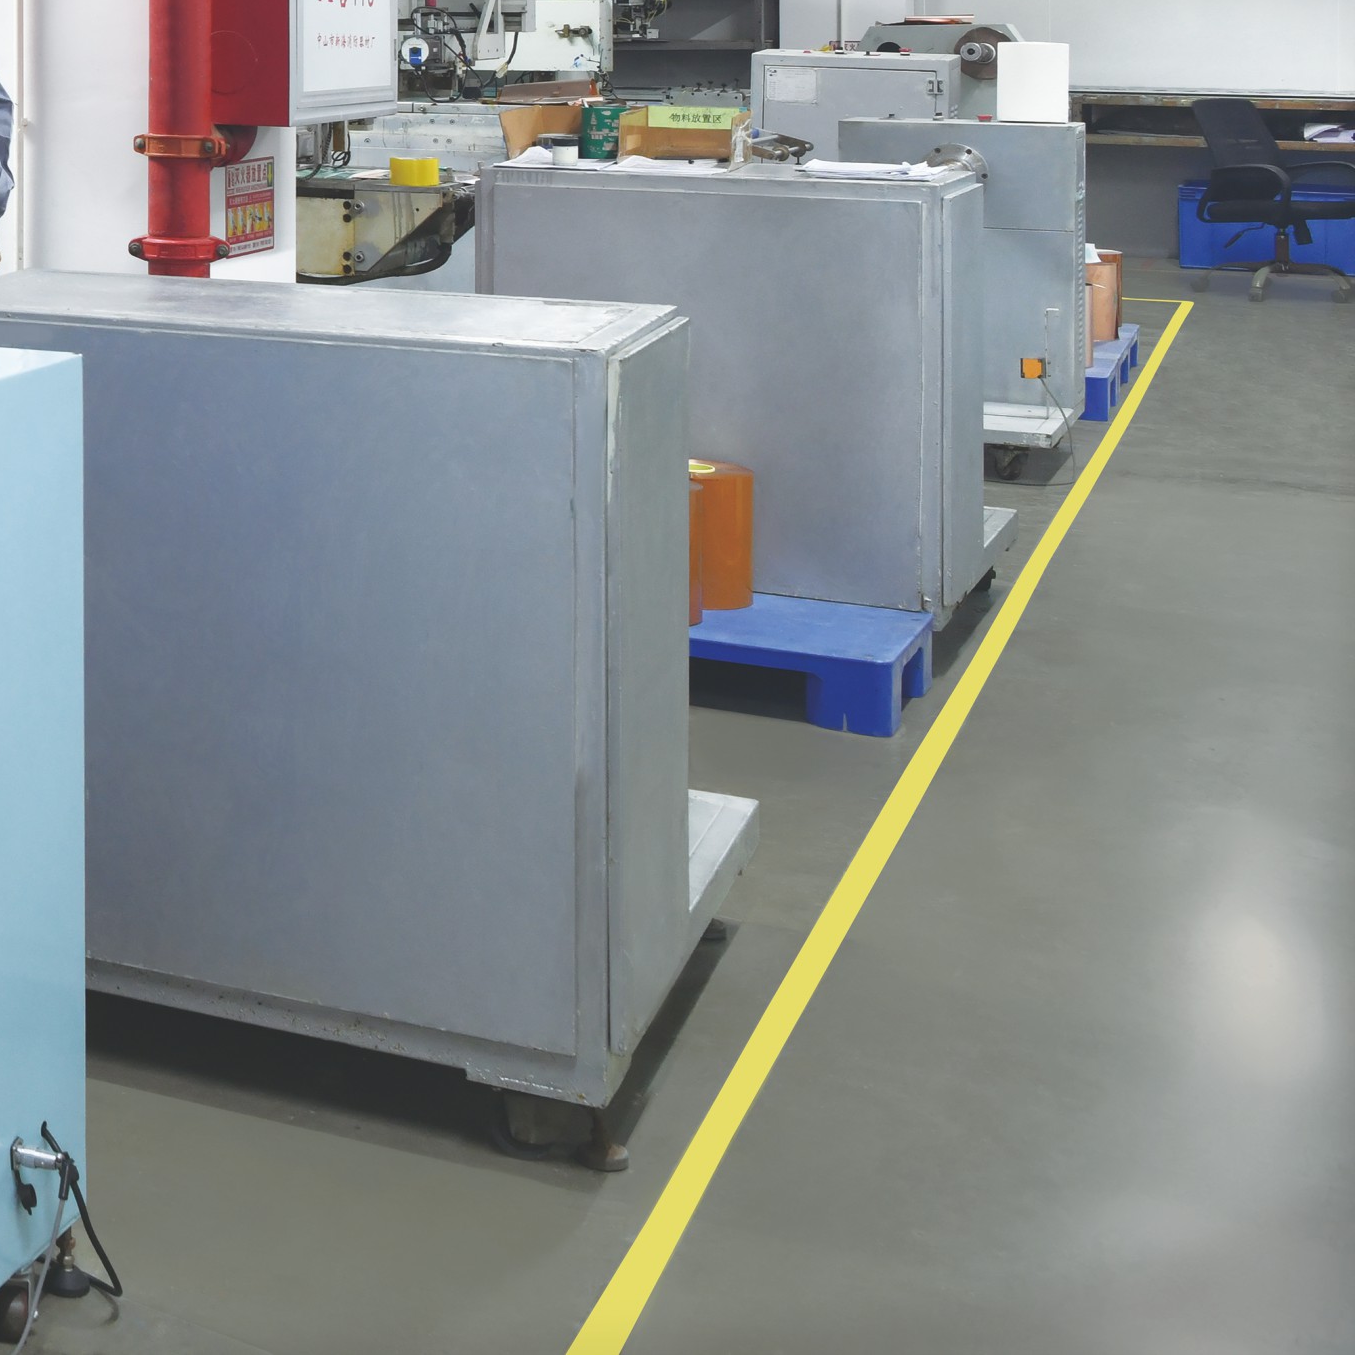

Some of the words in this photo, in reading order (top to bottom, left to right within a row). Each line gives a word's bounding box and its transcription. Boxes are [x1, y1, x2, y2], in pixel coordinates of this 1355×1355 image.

[669, 113, 722, 124] 物料放置区
